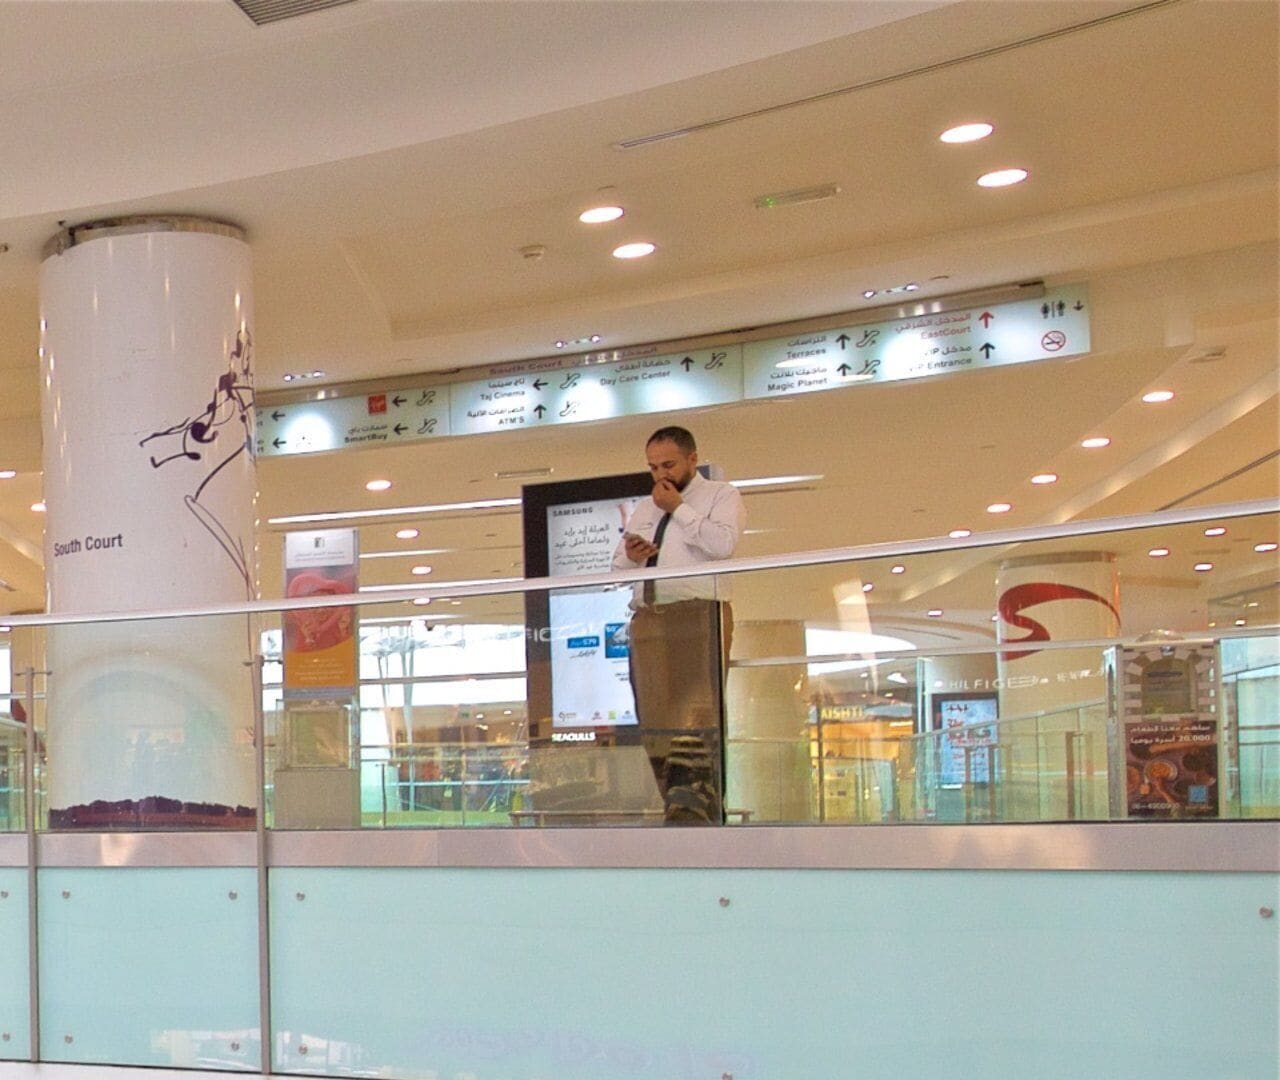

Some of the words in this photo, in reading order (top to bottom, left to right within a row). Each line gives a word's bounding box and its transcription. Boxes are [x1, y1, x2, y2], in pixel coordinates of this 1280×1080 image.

[786, 347, 827, 359] Terraces
[927, 357, 973, 370] Entrance
[600, 377, 617, 388] Day
[619, 373, 639, 384] Care
[640, 370, 671, 381] Center
[767, 381, 795, 392] Magic
[797, 377, 828, 388] Planet
[480, 393, 493, 402] Taj
[493, 389, 526, 400] Cinema
[344, 433, 388, 444] SmartBuy
[552, 506, 594, 518] SAMSUNG
[53, 538, 82, 558] South
[84, 532, 123, 552] Court
